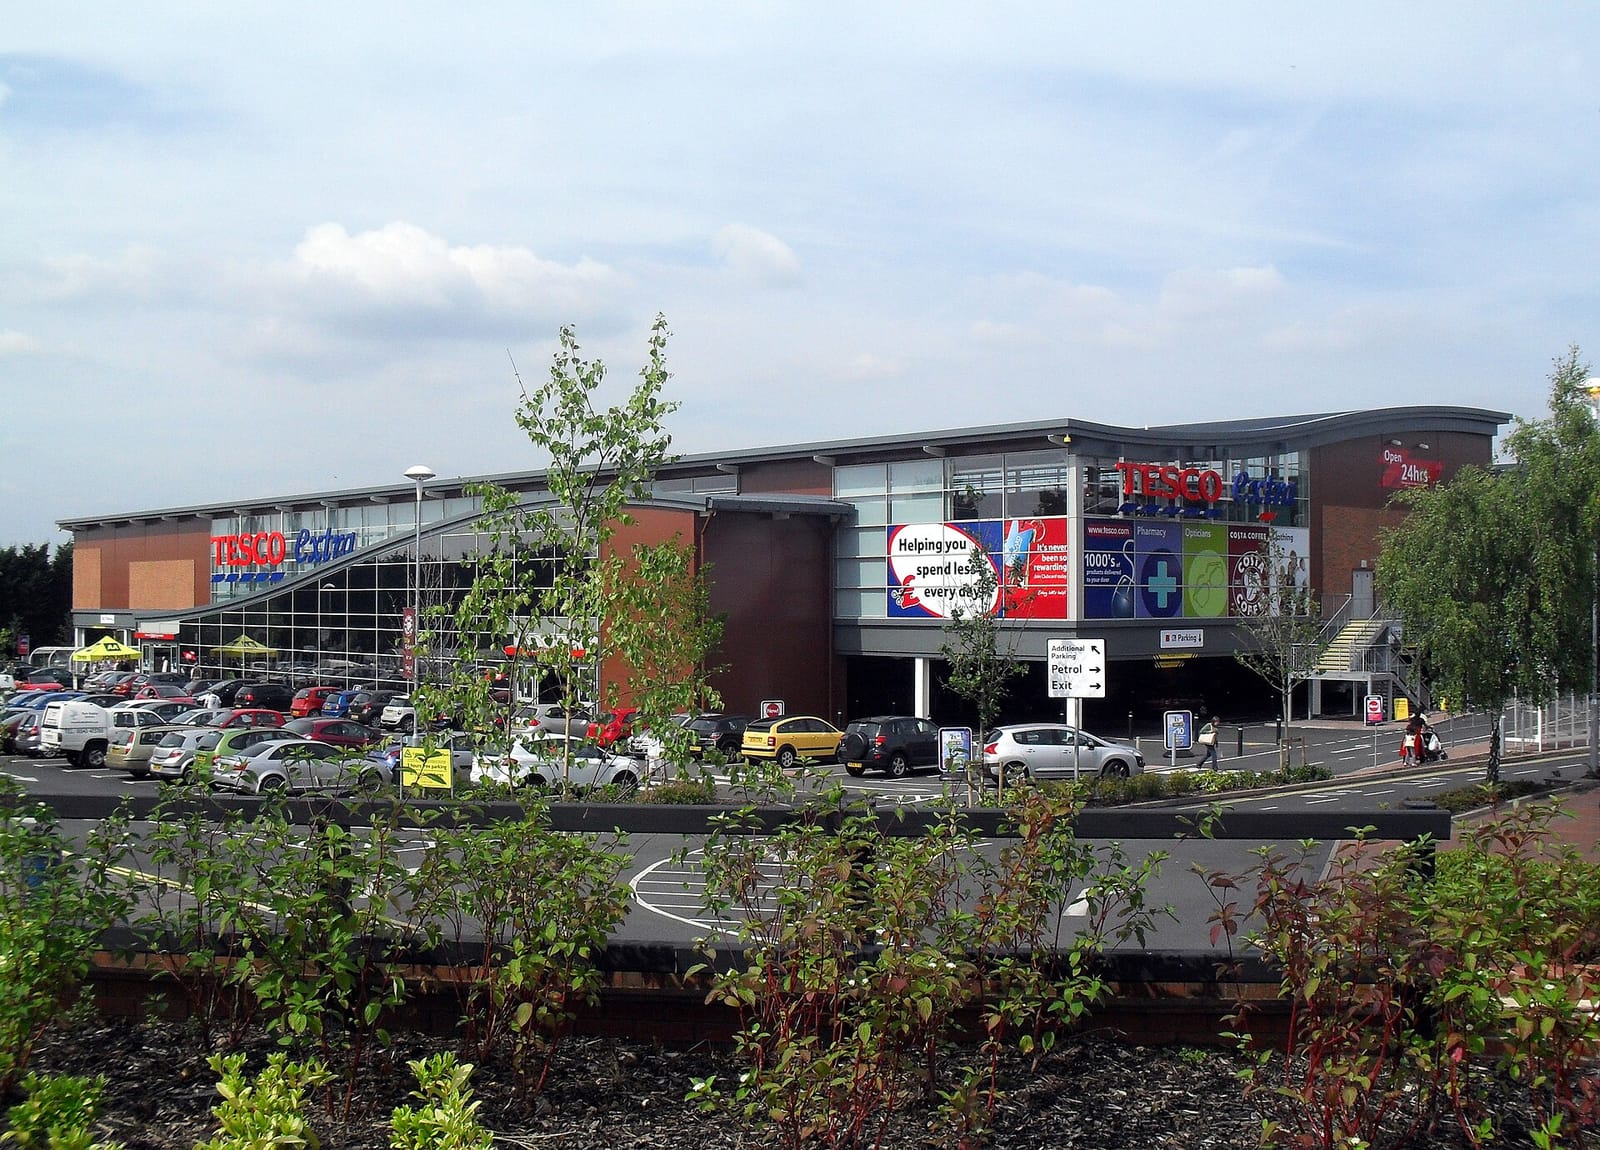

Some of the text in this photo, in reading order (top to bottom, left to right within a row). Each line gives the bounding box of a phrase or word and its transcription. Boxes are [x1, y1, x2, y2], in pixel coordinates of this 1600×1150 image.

[1384, 450, 1402, 464] Open
[1401, 464, 1428, 483] 24hrs
[1115, 462, 1223, 503] TESCO
[1088, 526, 1130, 535] www.tesco.com
[1137, 526, 1167, 538] Pharmacy
[1185, 527, 1211, 538] Opticians
[1229, 531, 1267, 540] COSTA COFFEE
[210, 531, 286, 566] TESCO
[899, 537, 967, 554] Helping you
[1041, 554, 1059, 562] been
[1085, 553, 1116, 568] 1000's
[916, 561, 951, 578] spend
[1033, 563, 1068, 573] rewarding
[1237, 556, 1265, 574] COSTA
[924, 588, 956, 601] every
[1177, 635, 1197, 643] Parking
[1051, 653, 1077, 661] Parking
[1051, 665, 1083, 674] Petrol
[1051, 681, 1073, 690] Exit
